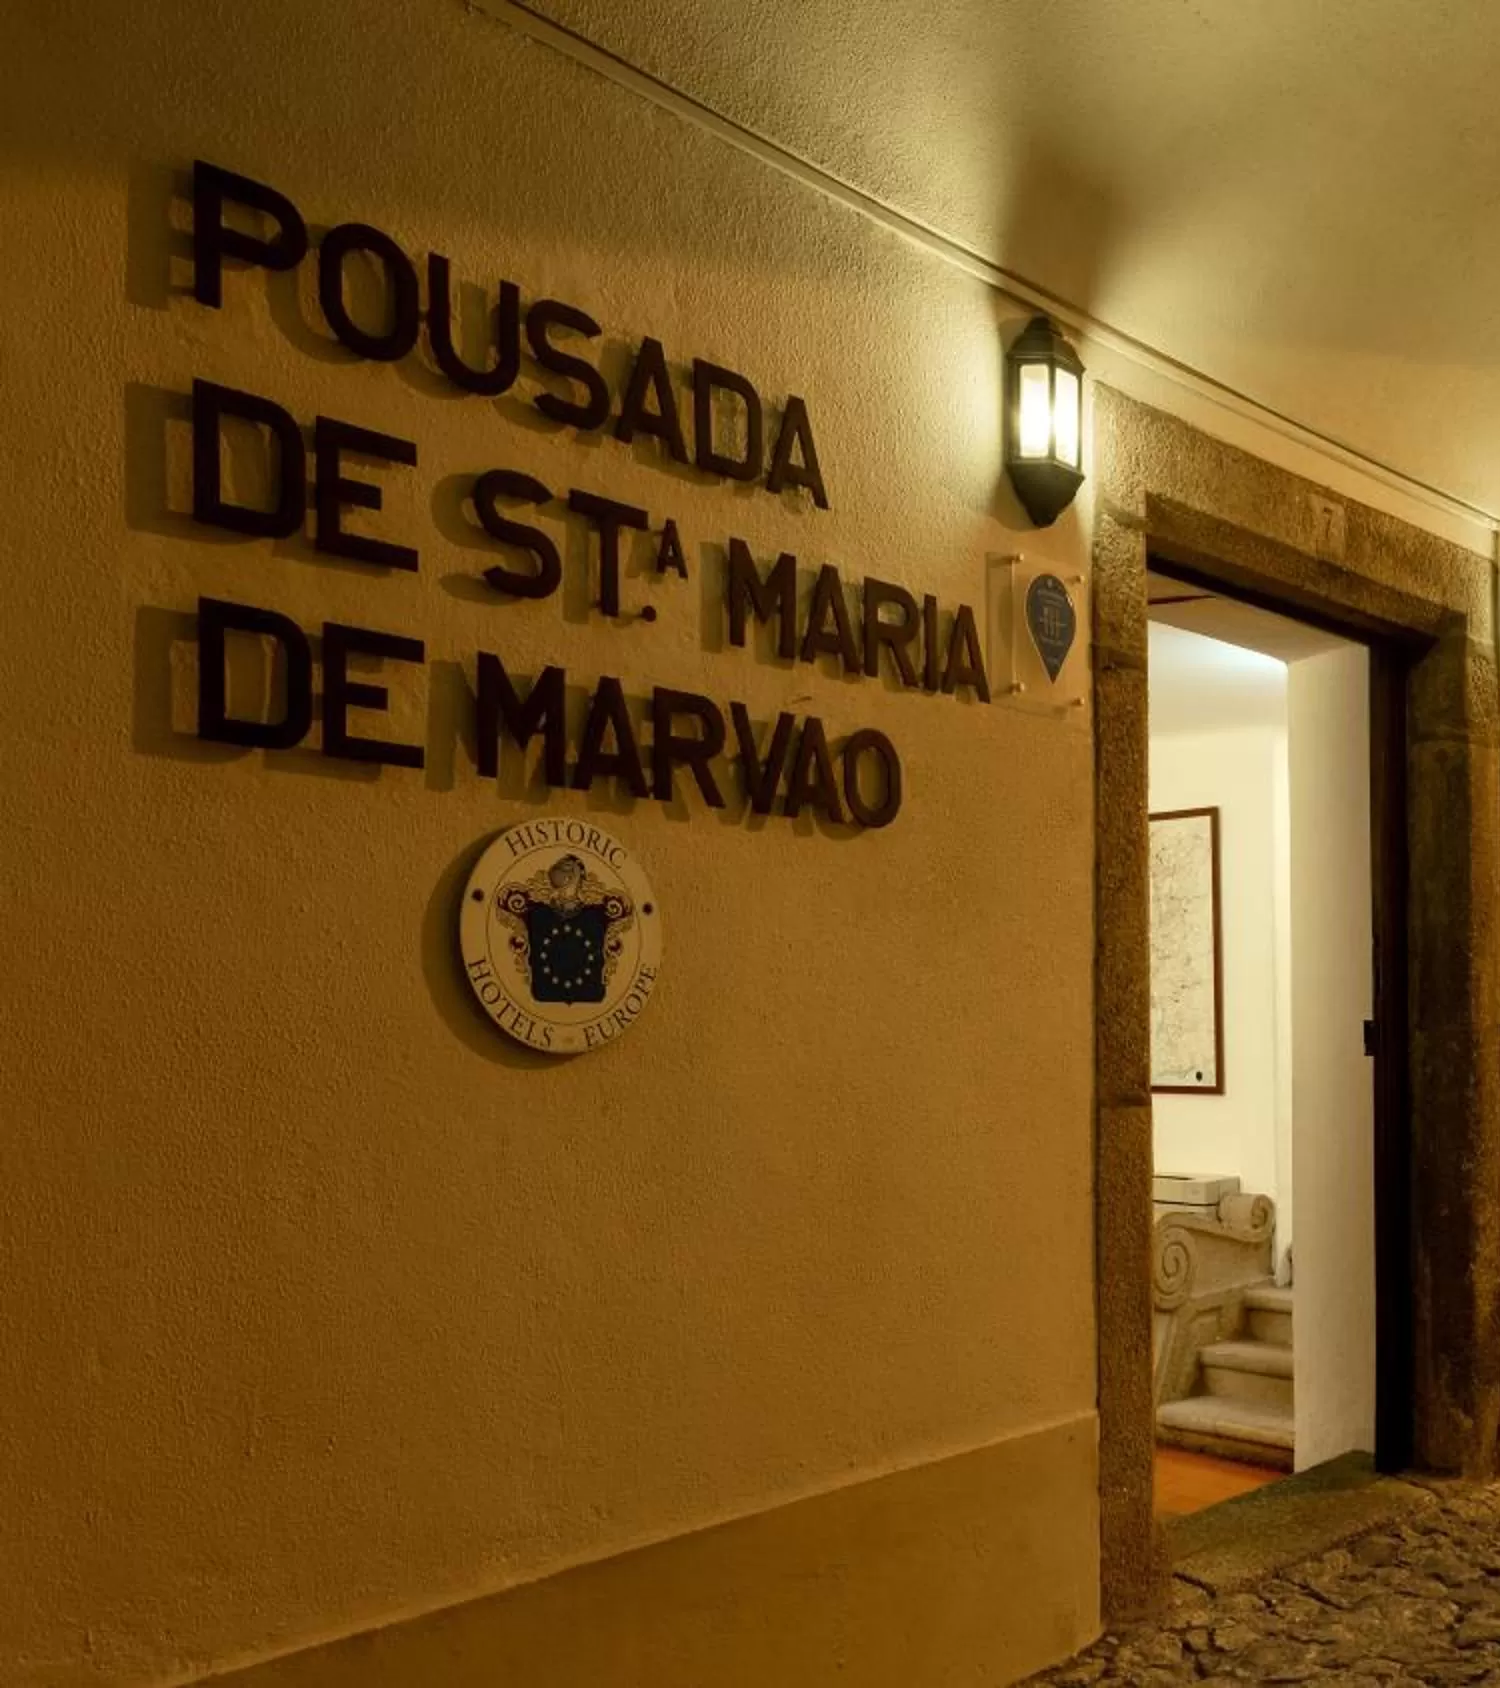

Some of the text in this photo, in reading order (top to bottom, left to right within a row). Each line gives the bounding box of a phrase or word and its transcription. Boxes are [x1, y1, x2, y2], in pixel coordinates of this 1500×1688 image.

[194, 159, 828, 510] POUSADA
[193, 378, 418, 573] DE
[729, 538, 990, 704] MARIA
[197, 596, 425, 769] DE
[504, 819, 628, 870] HISTORIC
[467, 956, 658, 1048] HOTELS EUROPE
